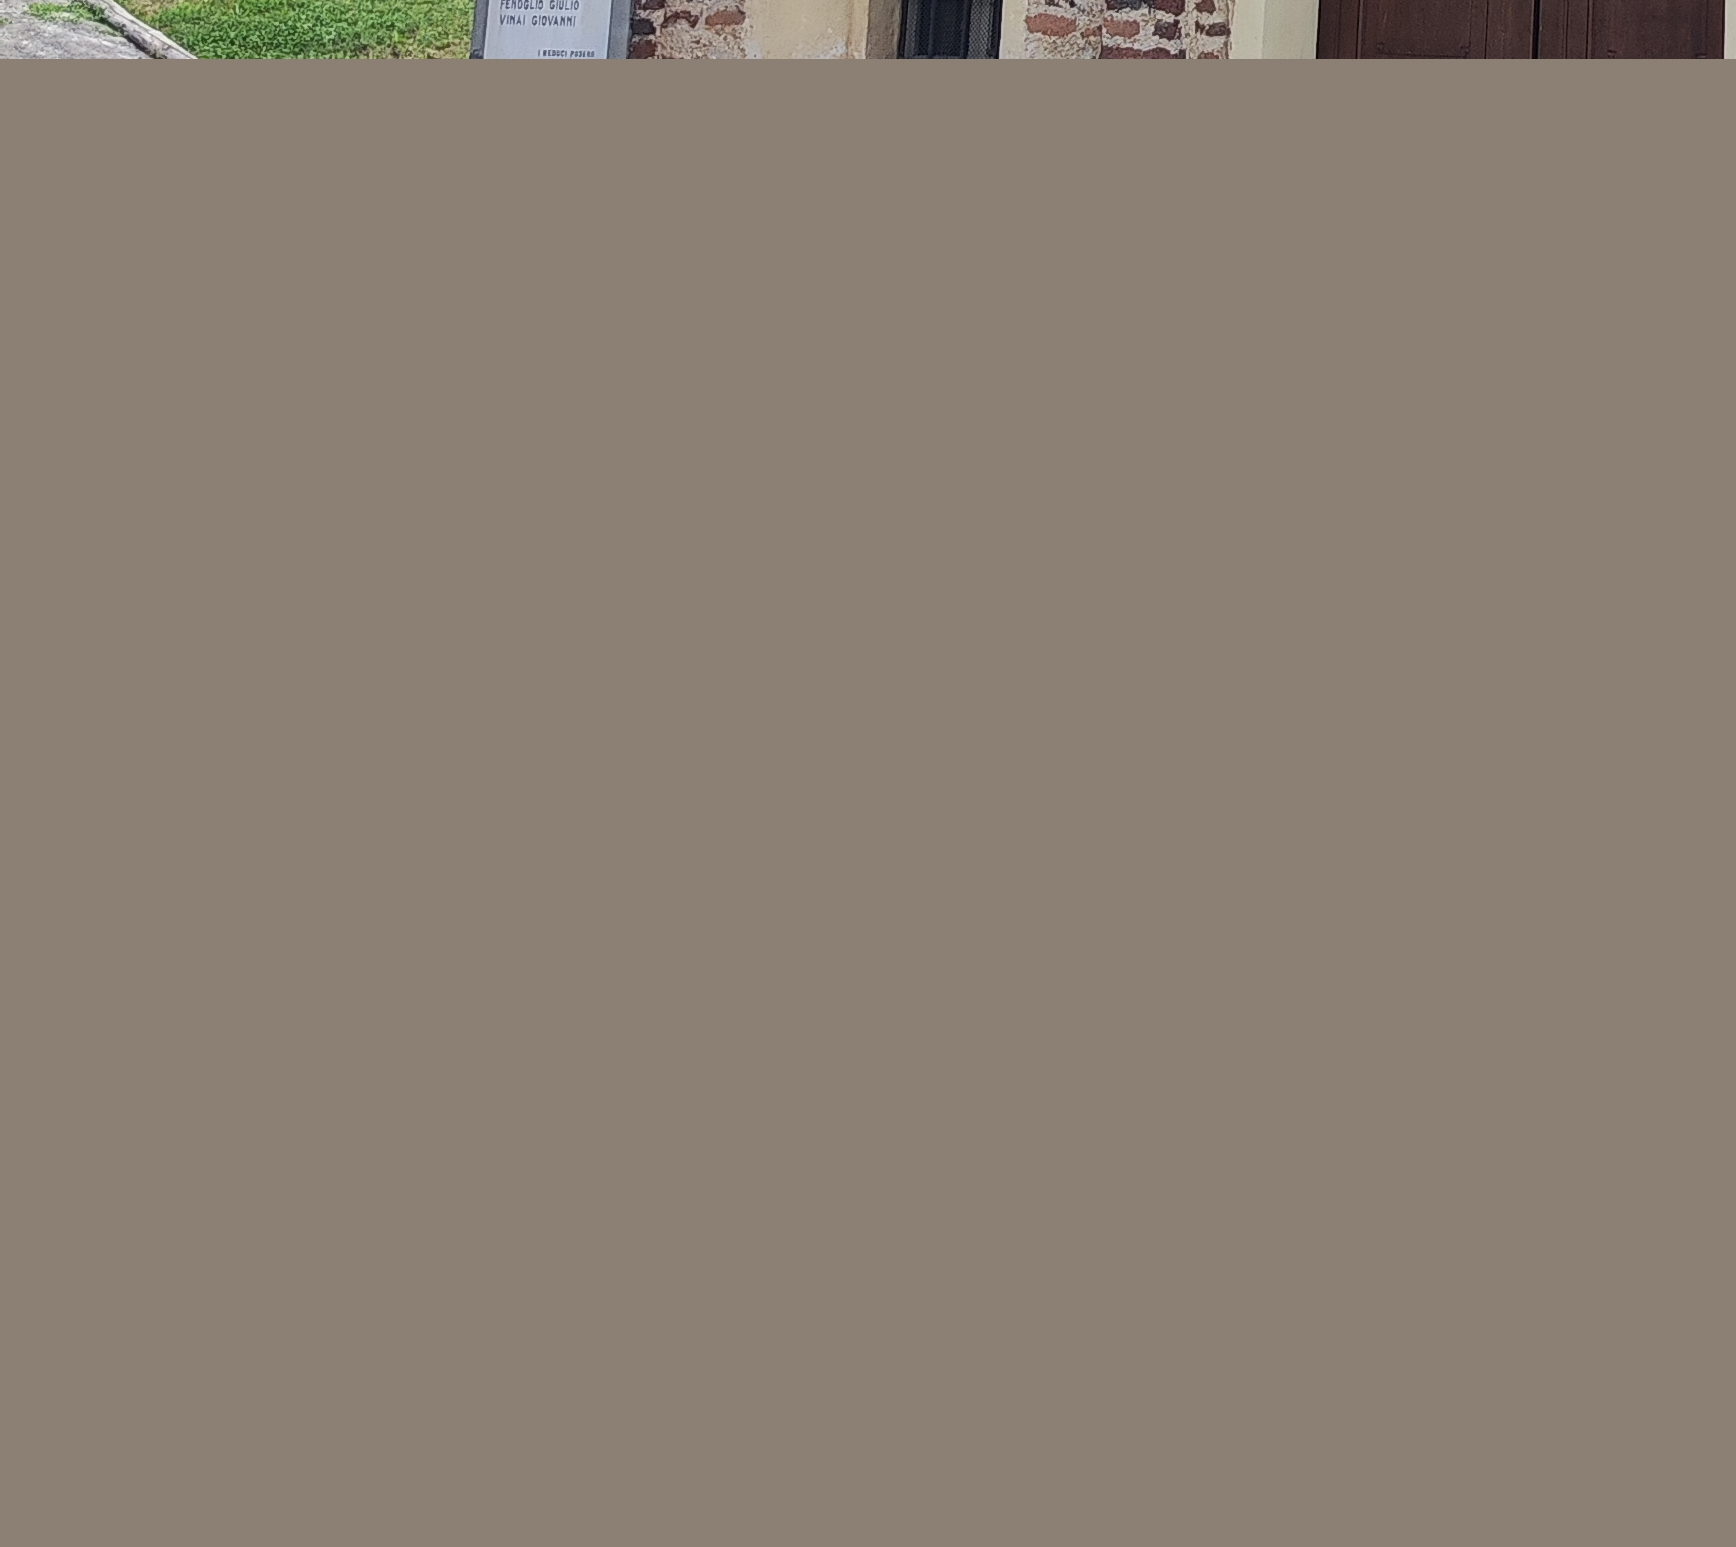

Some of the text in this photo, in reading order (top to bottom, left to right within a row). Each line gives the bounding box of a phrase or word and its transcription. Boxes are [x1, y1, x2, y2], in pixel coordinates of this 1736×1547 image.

[549, 0, 580, 11] GIULIO
[499, 14, 577, 27] VINAI GIOVANNI
